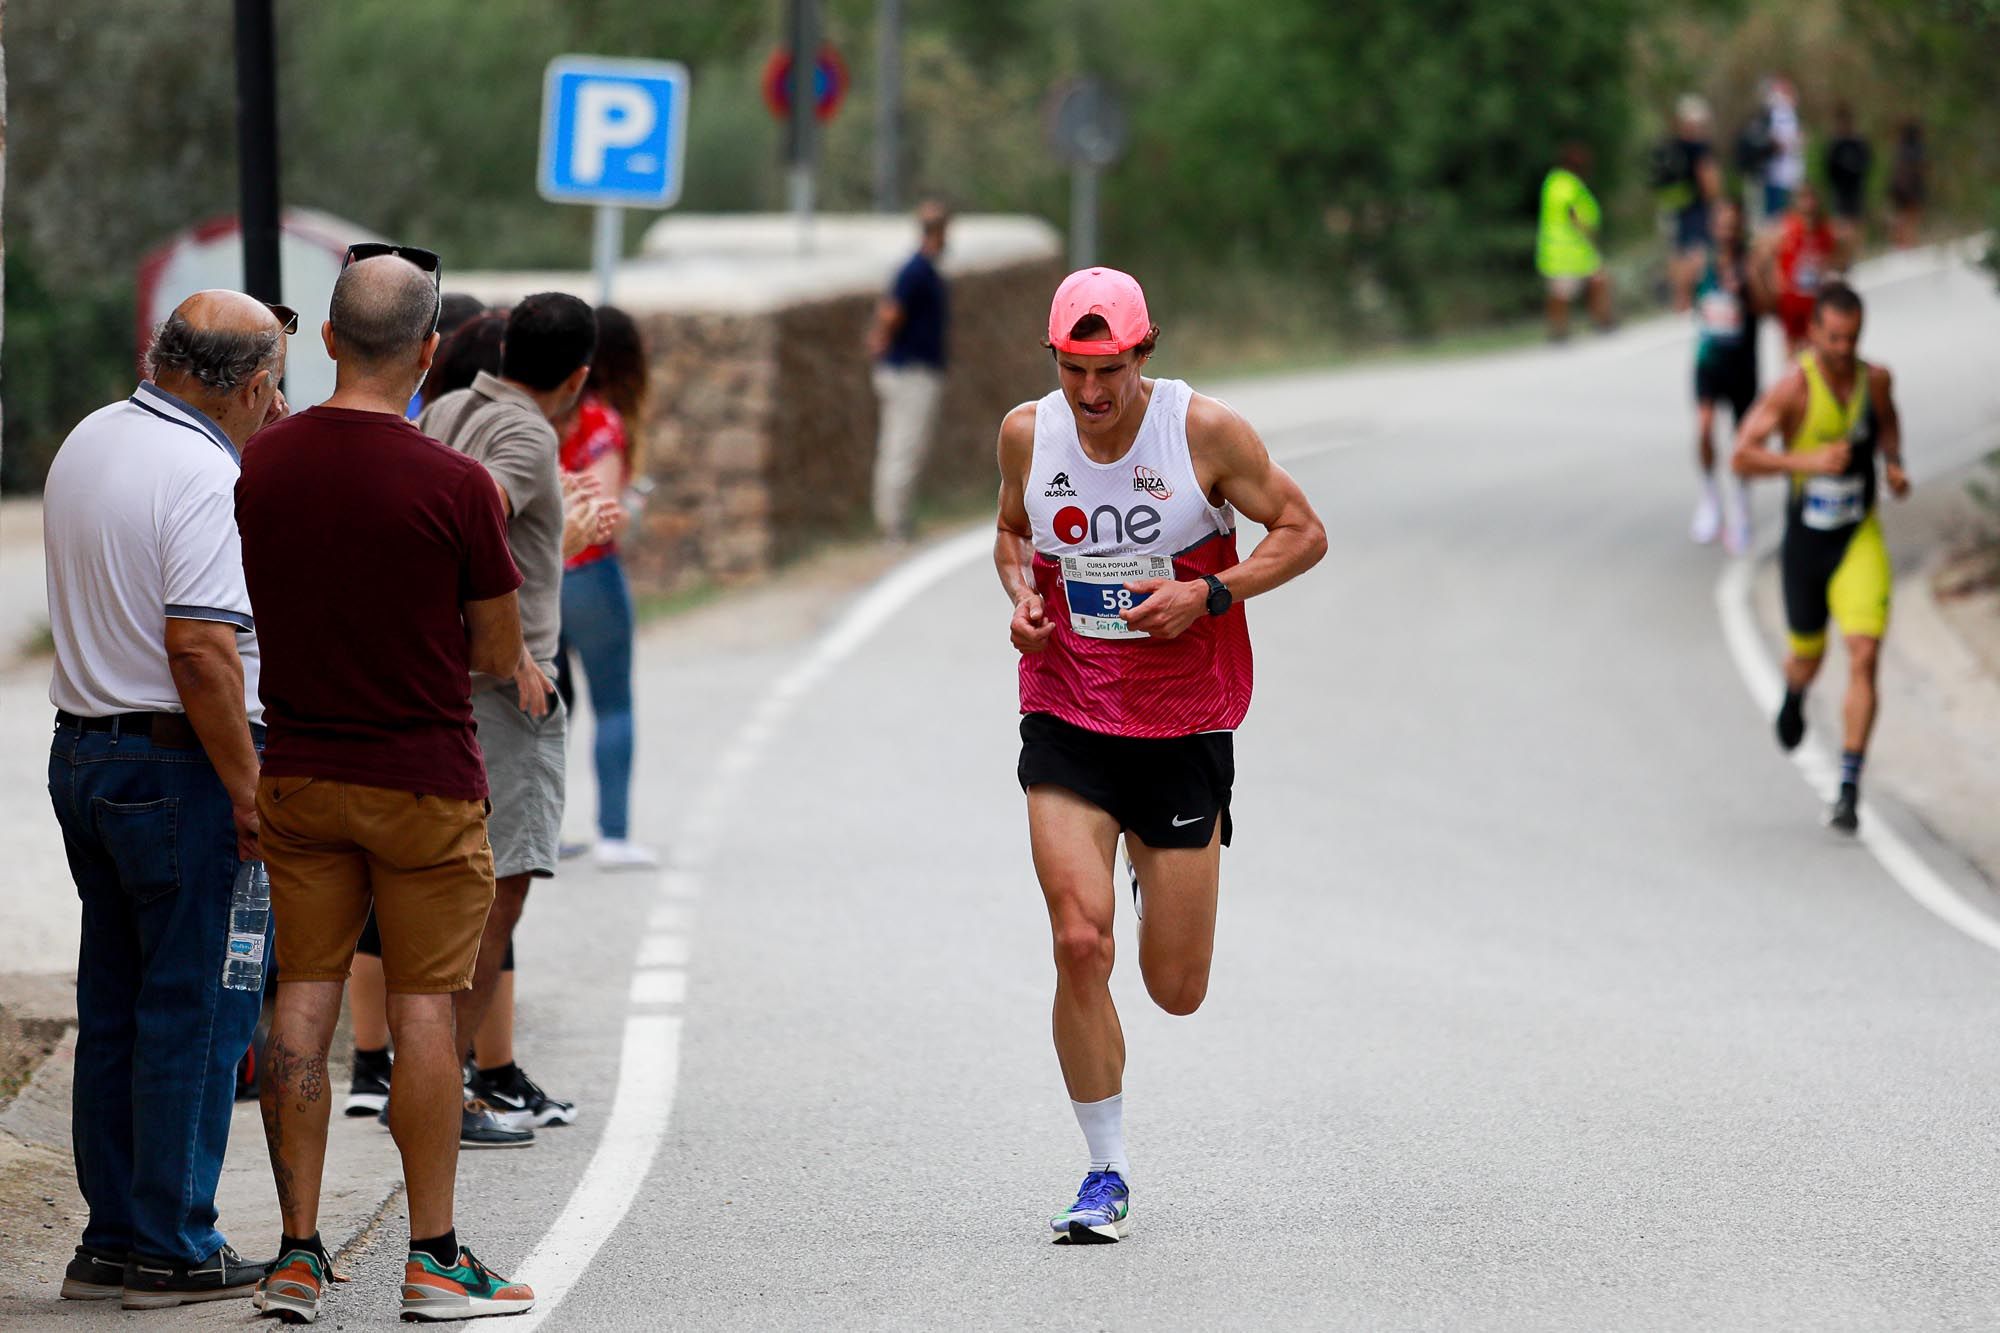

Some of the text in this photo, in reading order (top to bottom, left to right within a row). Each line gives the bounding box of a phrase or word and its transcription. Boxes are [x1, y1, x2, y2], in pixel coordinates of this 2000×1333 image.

[571, 81, 657, 183] P
[1133, 477, 1165, 489] IBIZA
[1108, 561, 1139, 569] POPULAR
[1064, 570, 1082, 578] crea
[1120, 569, 1144, 577] MATEU
[1148, 568, 1170, 578] crea
[1101, 589, 1133, 610] 58
